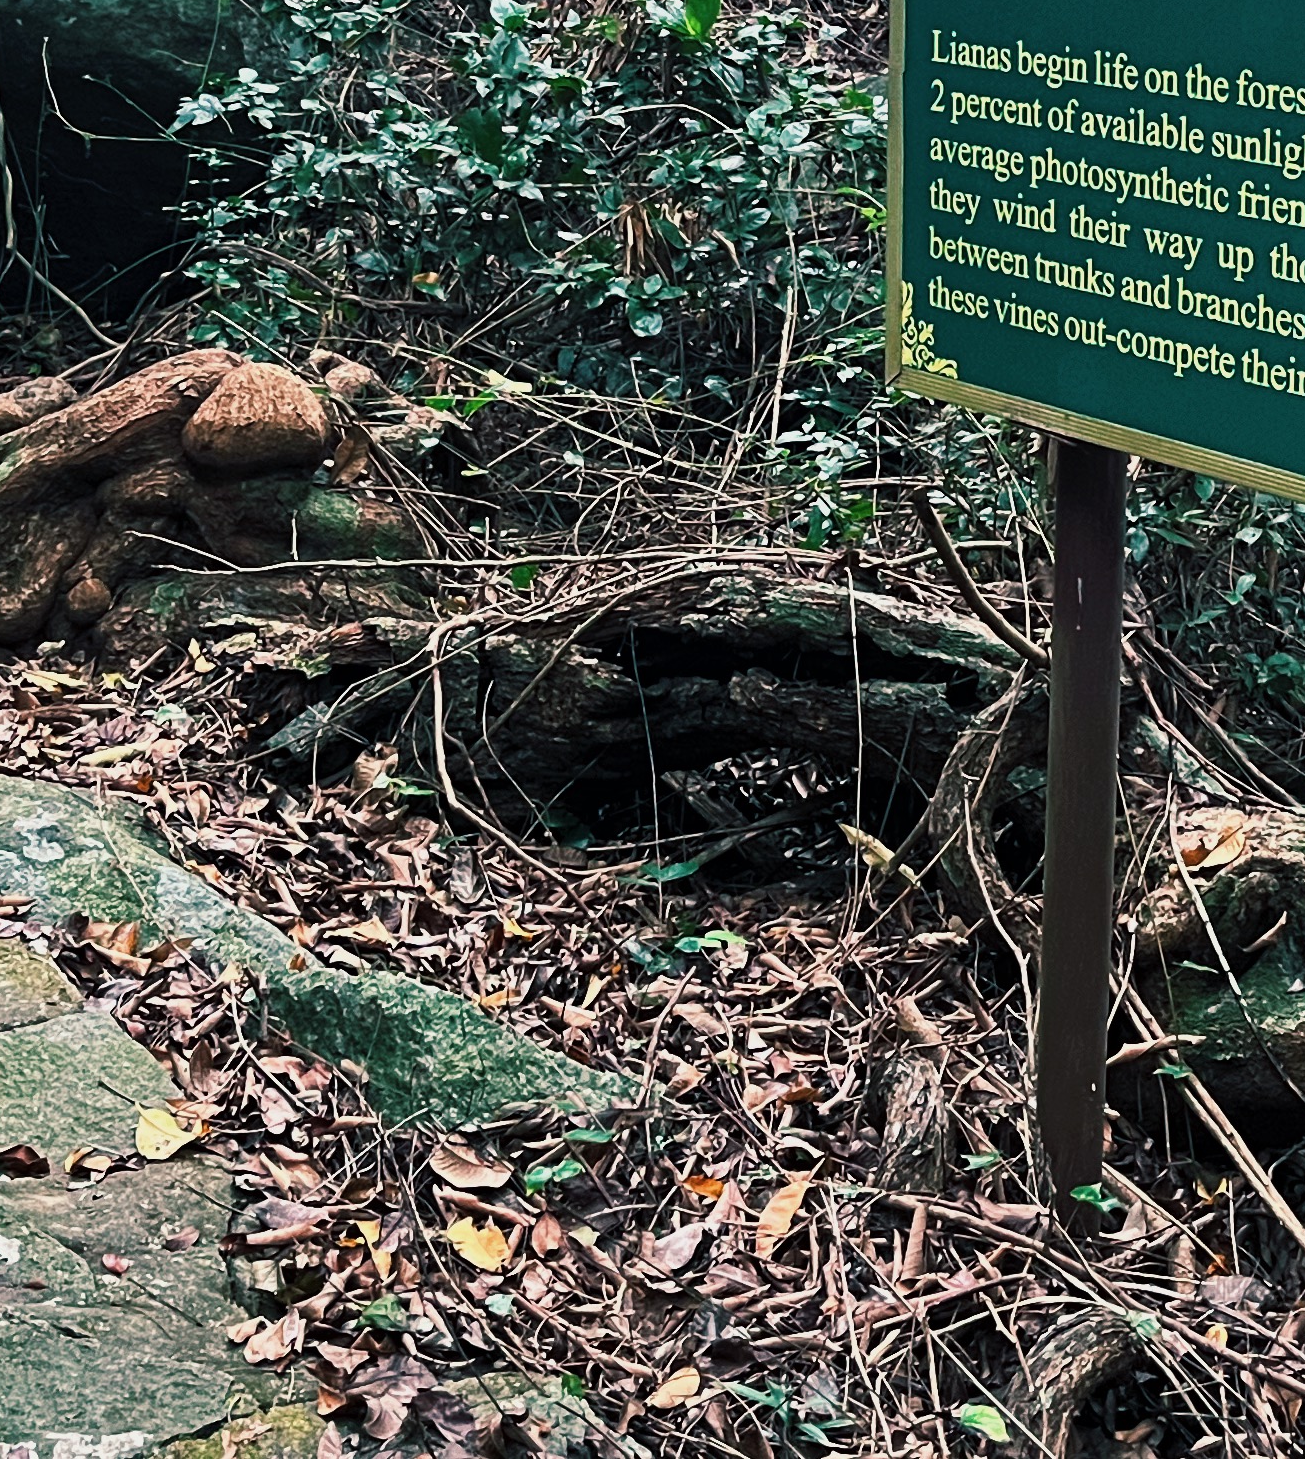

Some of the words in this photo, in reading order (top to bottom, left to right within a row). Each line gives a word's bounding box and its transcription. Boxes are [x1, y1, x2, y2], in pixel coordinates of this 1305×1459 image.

[932, 30, 1011, 72] Lianas
[1017, 40, 1088, 88] begin
[1095, 50, 1138, 90] life
[1145, 68, 1179, 96] on
[1186, 64, 1228, 102] the
[931, 79, 944, 111] 2
[951, 92, 1041, 127] percent
[1048, 99, 1079, 133] of
[1081, 108, 1204, 153] available
[931, 138, 1023, 182] average
[1030, 148, 1228, 212] photosynthetic
[929, 226, 1029, 278] between
[1035, 253, 1114, 297] trunks
[1121, 275, 1171, 309] and
[930, 179, 980, 224] they
[993, 193, 1056, 232] wind
[1070, 205, 1130, 247] their
[1144, 228, 1203, 270] way
[1217, 242, 1253, 281] up
[929, 276, 988, 318] these
[994, 293, 1058, 336] vines
[1065, 317, 1235, 378] out-compete
